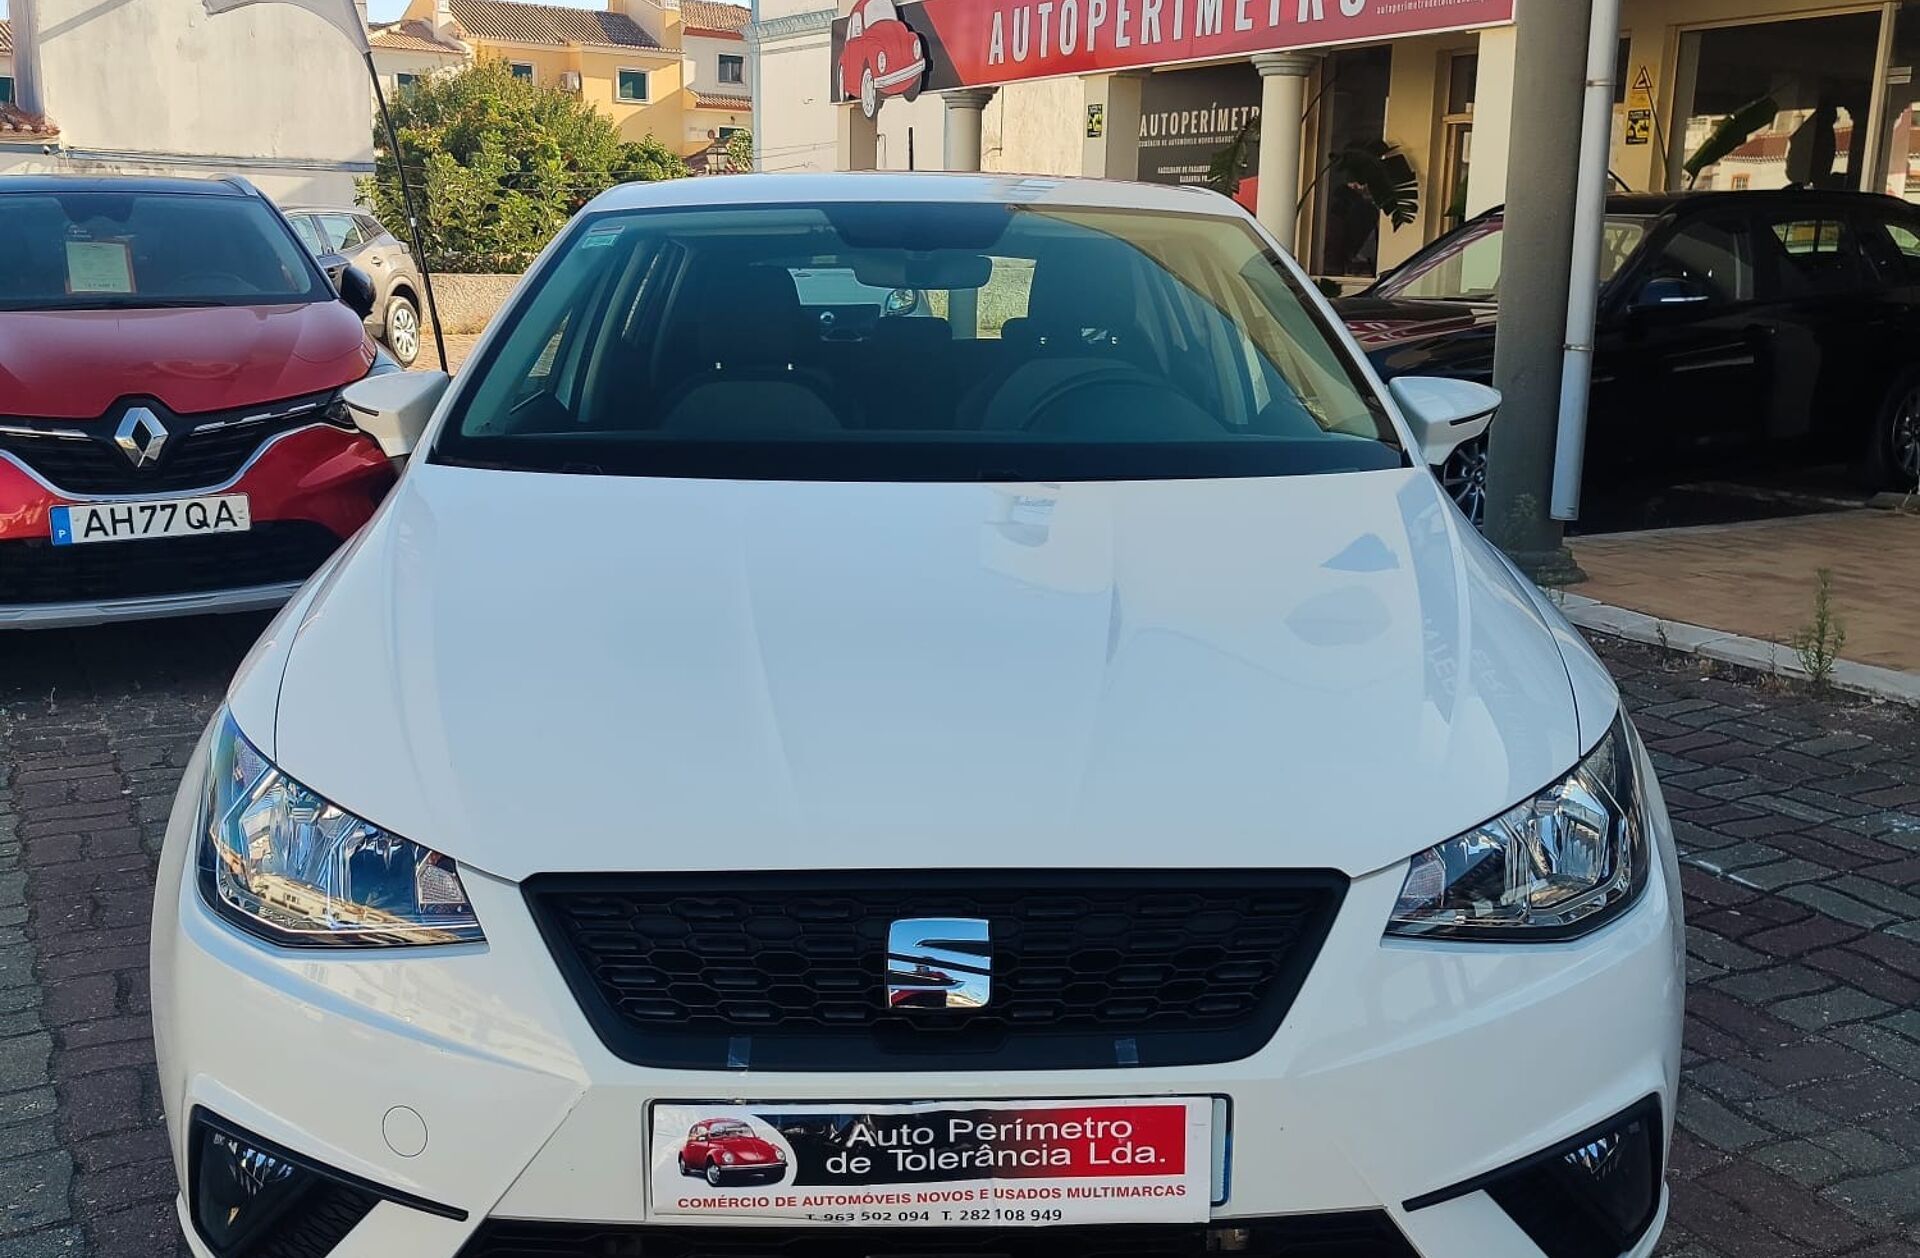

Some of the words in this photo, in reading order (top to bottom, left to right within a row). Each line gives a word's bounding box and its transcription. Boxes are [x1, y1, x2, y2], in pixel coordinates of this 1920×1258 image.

[1139, 102, 1260, 137] AUTOPERÍMETR
[58, 529, 66, 538] P
[845, 1122, 935, 1148] Auto
[949, 1115, 1133, 1143] Perímetro
[825, 1151, 872, 1175] de
[887, 1143, 1072, 1172] Tolerância
[1088, 1141, 1167, 1165] Lda.
[677, 1194, 770, 1209] COMÉRCIO
[775, 1197, 797, 1208] DE
[802, 1191, 912, 1207] AUTOMÓVEIS
[917, 1189, 974, 1203] NOVOS
[979, 1189, 989, 1200] E
[994, 1187, 1062, 1200] USADOS
[1067, 1184, 1187, 1199] MULTIMARCAS
[824, 1211, 855, 1222] 963
[860, 1211, 892, 1221] 502
[898, 1211, 930, 1222] 094
[941, 1210, 953, 1221] T.
[959, 1209, 991, 1221] 282
[995, 1209, 1025, 1221] 108
[1031, 1209, 1063, 1221] 949
